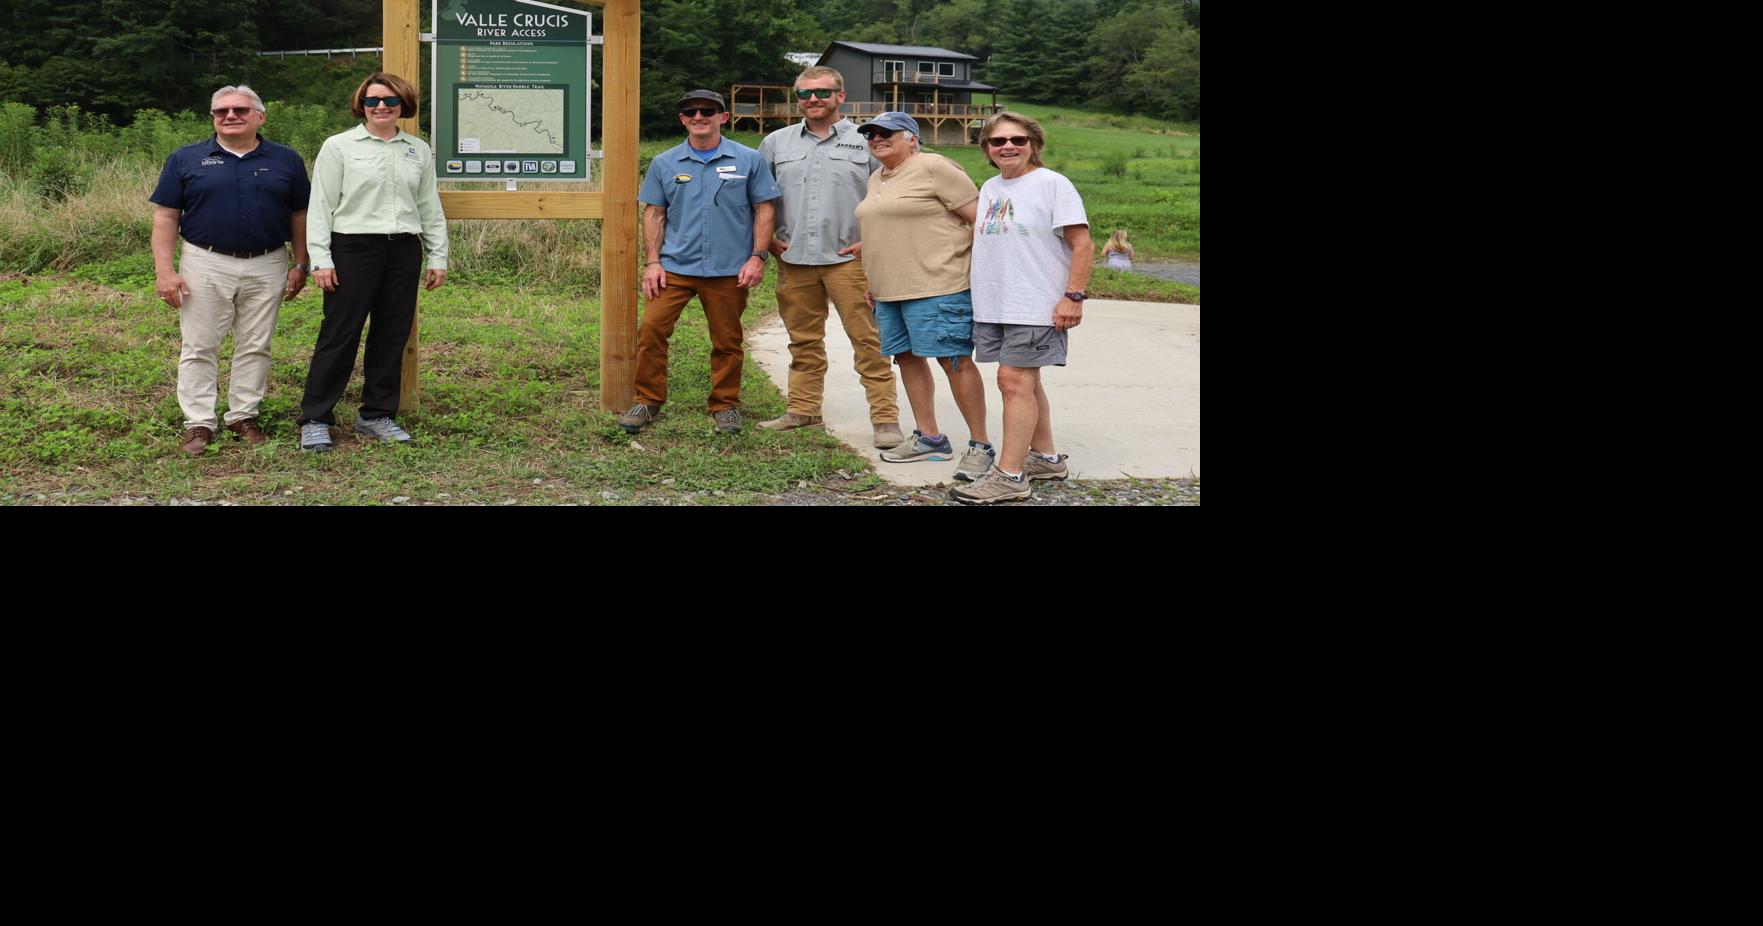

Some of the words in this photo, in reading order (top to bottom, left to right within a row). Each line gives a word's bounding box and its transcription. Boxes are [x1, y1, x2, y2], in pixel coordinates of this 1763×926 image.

[456, 12, 508, 26] VALLE
[513, 14, 568, 28] CRUCIS
[477, 28, 506, 36] RIVER
[511, 29, 546, 37] ACCESS
